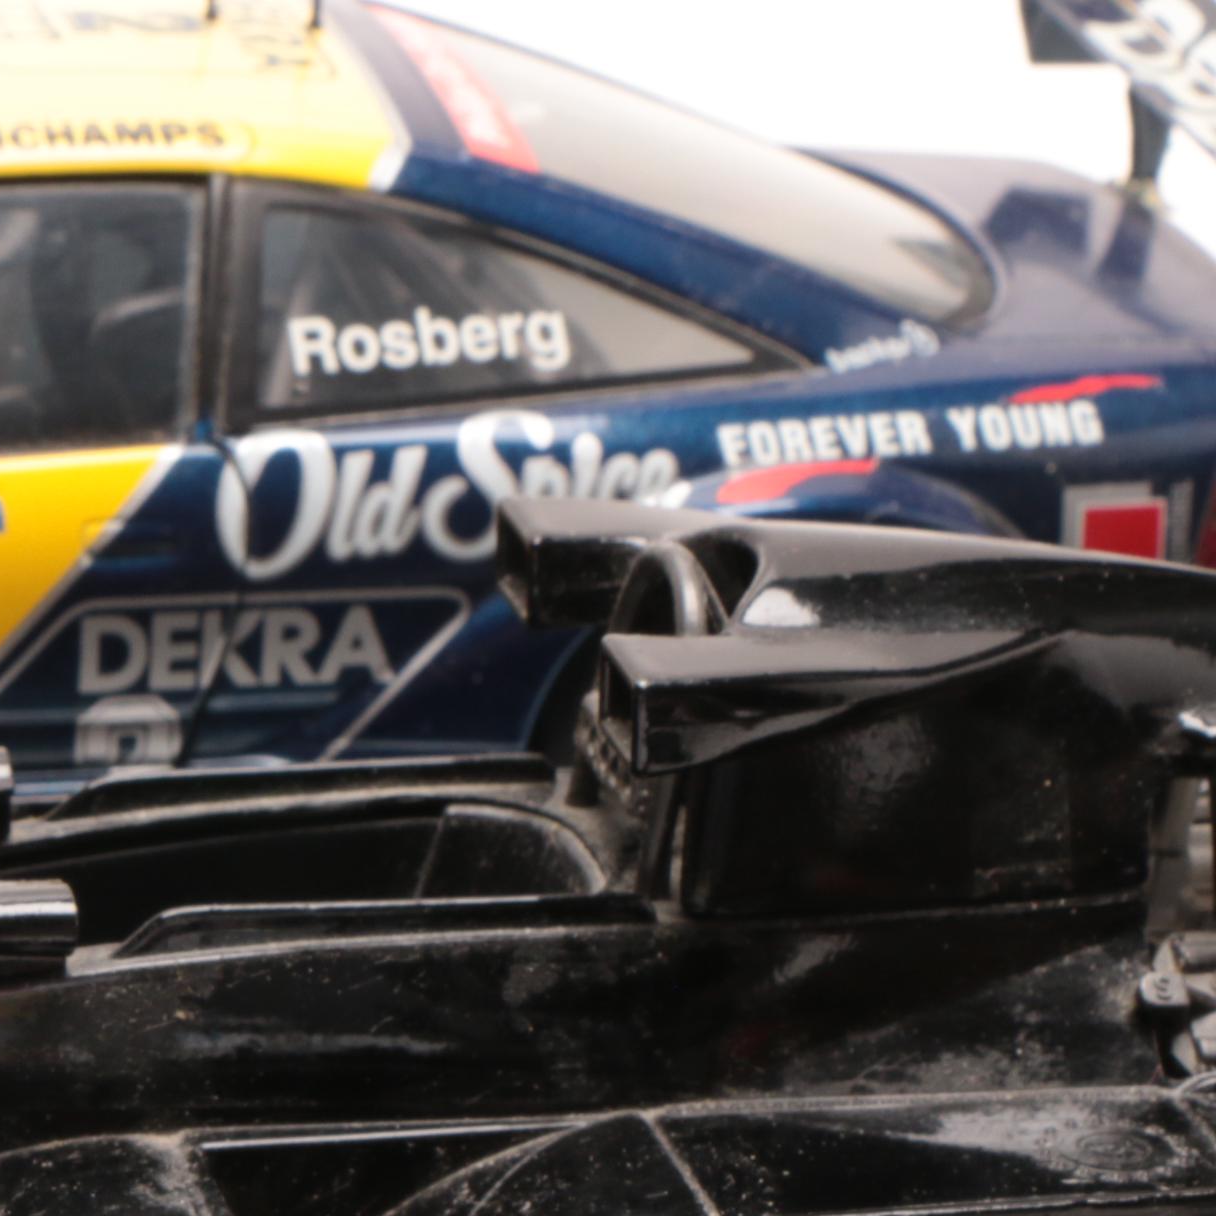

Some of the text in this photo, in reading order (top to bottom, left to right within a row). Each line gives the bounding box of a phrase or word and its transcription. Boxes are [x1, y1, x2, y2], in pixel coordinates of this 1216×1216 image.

[286, 305, 571, 376] Rosberg
[716, 399, 1105, 468] FOREVER YOUNG
[215, 428, 430, 581] Old
[76, 603, 399, 695] DEKRA
